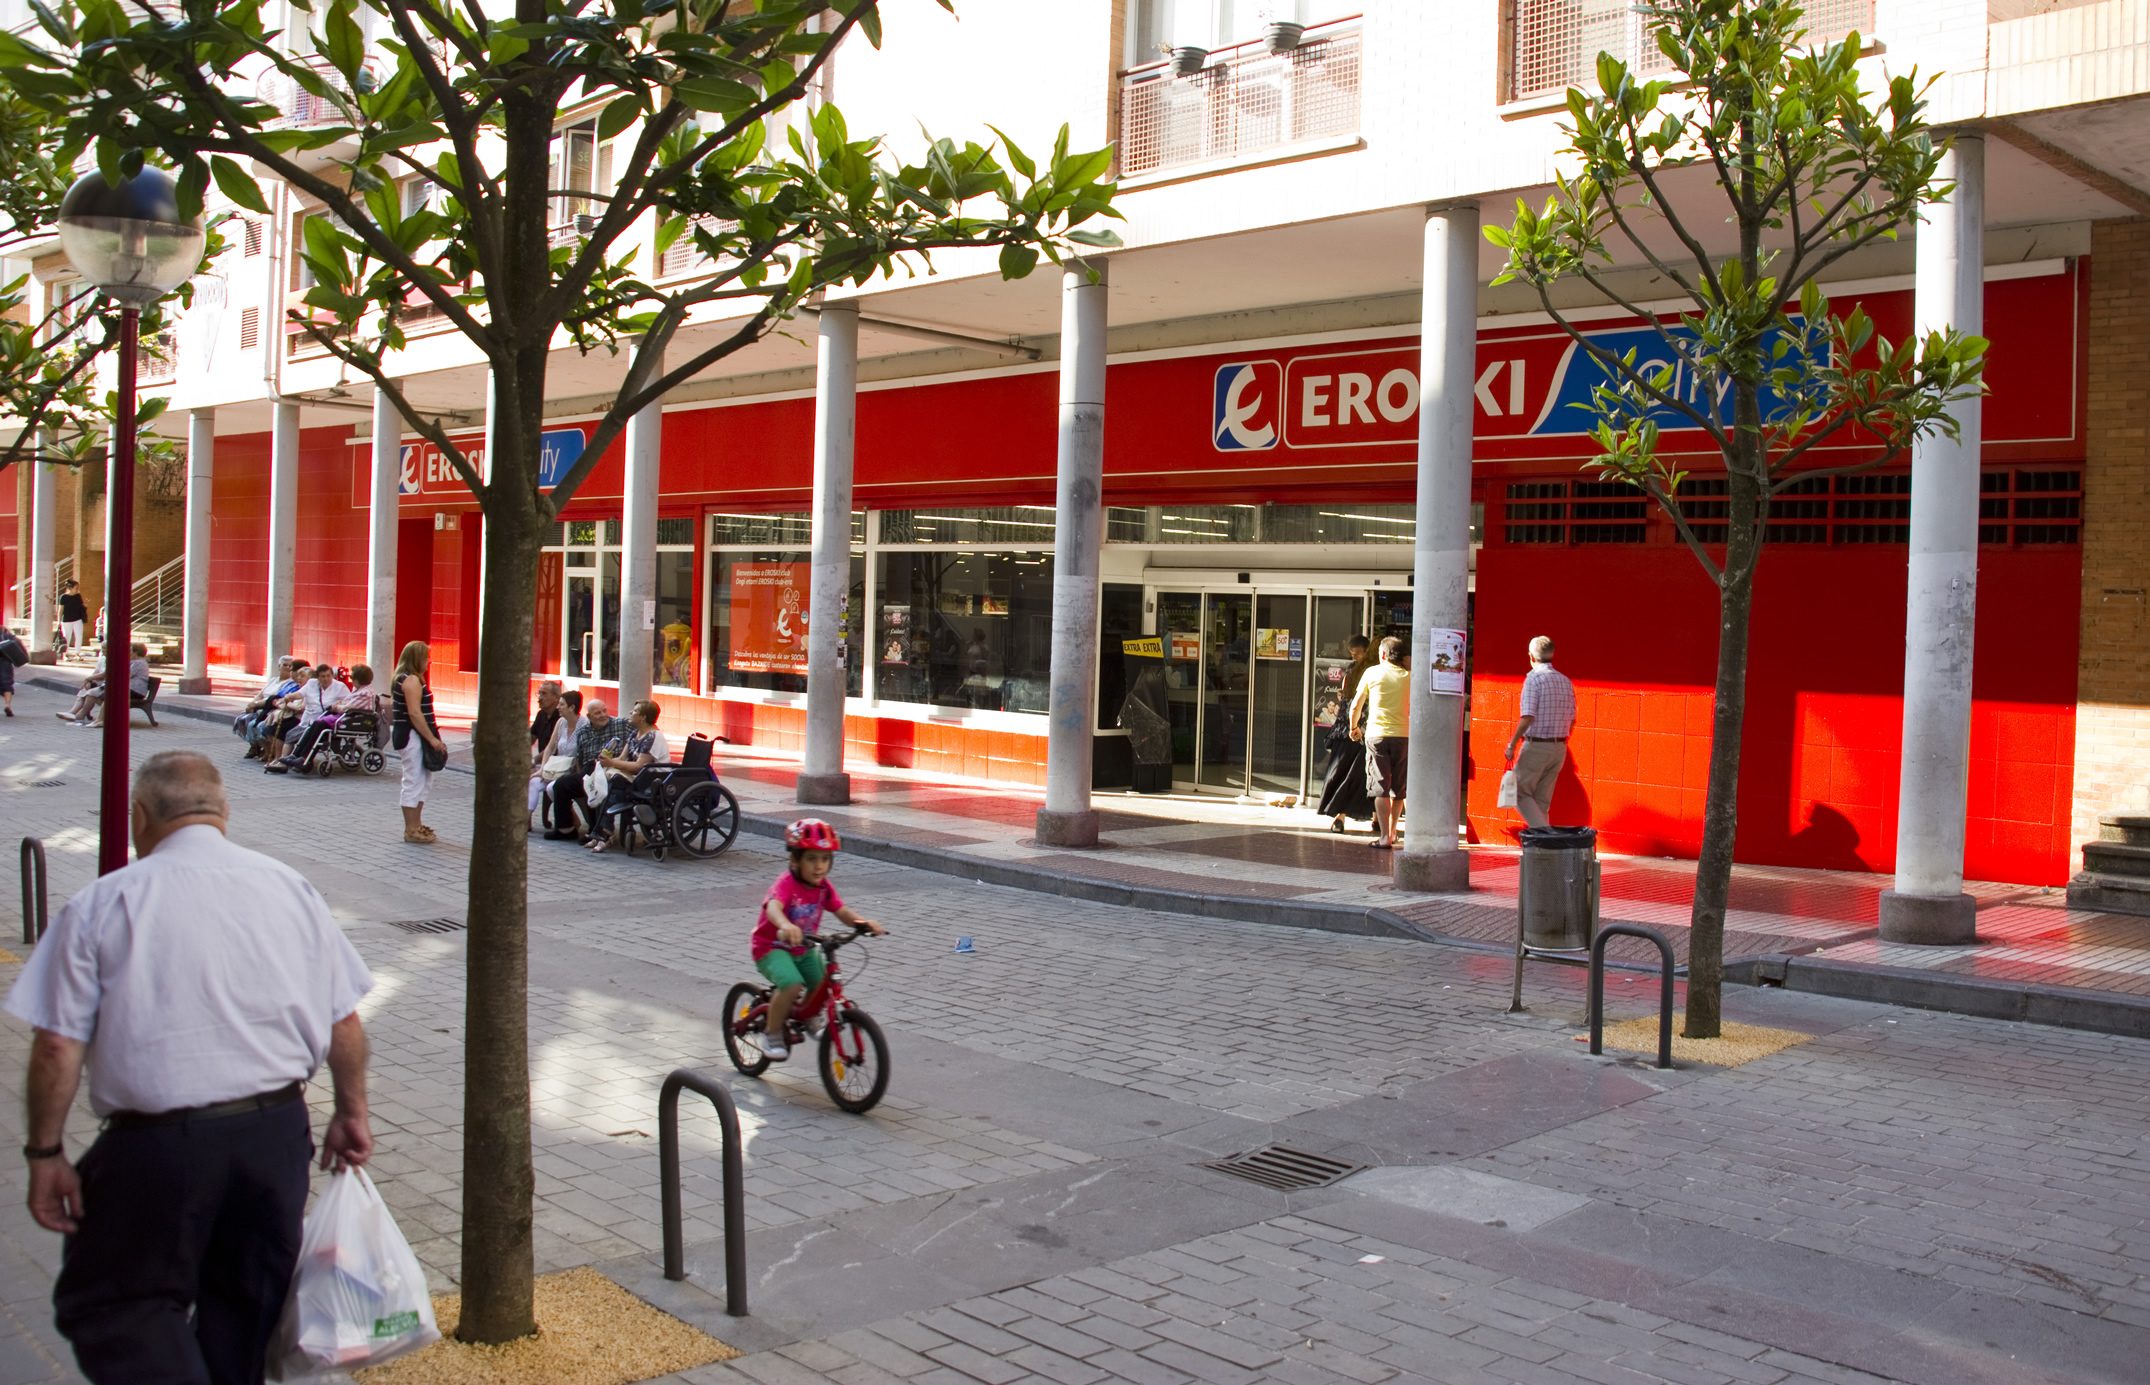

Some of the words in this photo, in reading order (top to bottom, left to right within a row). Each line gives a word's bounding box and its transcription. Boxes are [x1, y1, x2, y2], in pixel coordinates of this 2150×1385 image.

[1302, 360, 1525, 427] EROKI
[539, 440, 560, 482] ity
[1124, 643, 1141, 652] EXTRA
[1143, 642, 1161, 653] EXTRA
